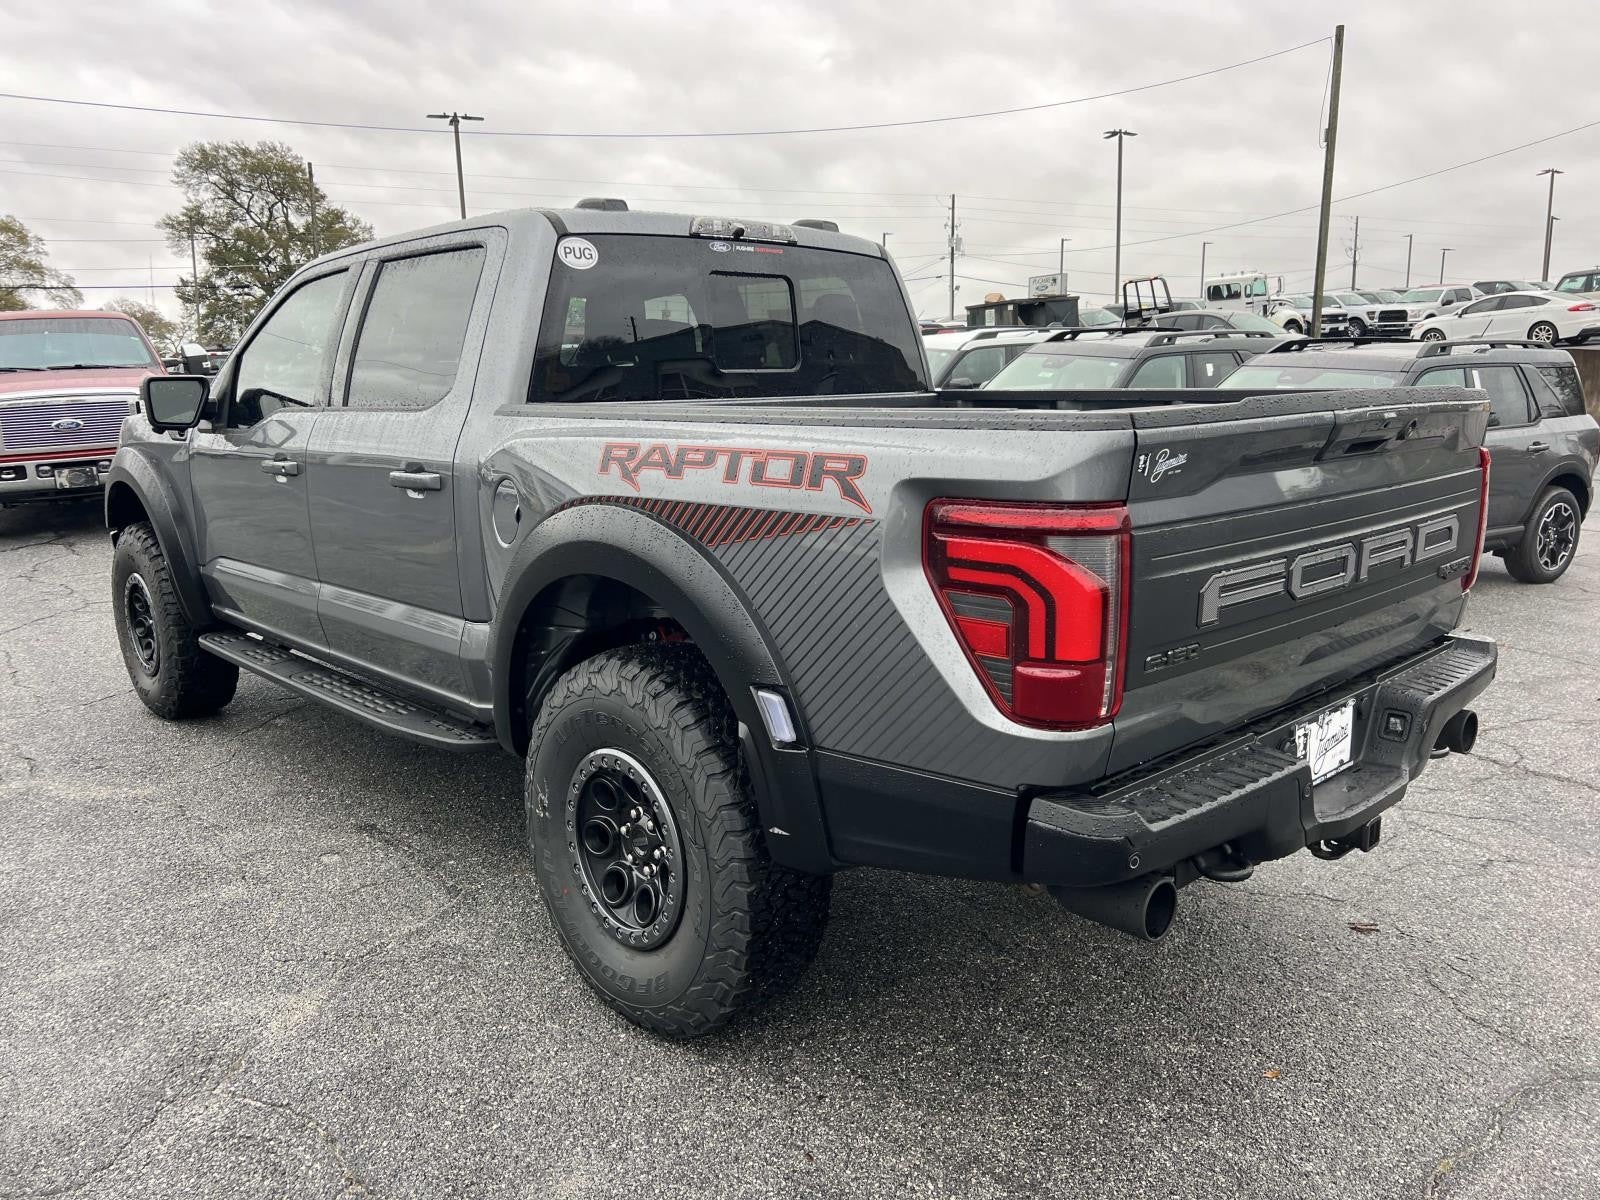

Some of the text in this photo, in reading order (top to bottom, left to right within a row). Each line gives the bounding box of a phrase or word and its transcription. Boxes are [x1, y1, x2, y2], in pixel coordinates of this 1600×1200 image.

[563, 246, 593, 260] PUG
[598, 442, 872, 514] RAPTOR
[1197, 513, 1460, 628] FORD
